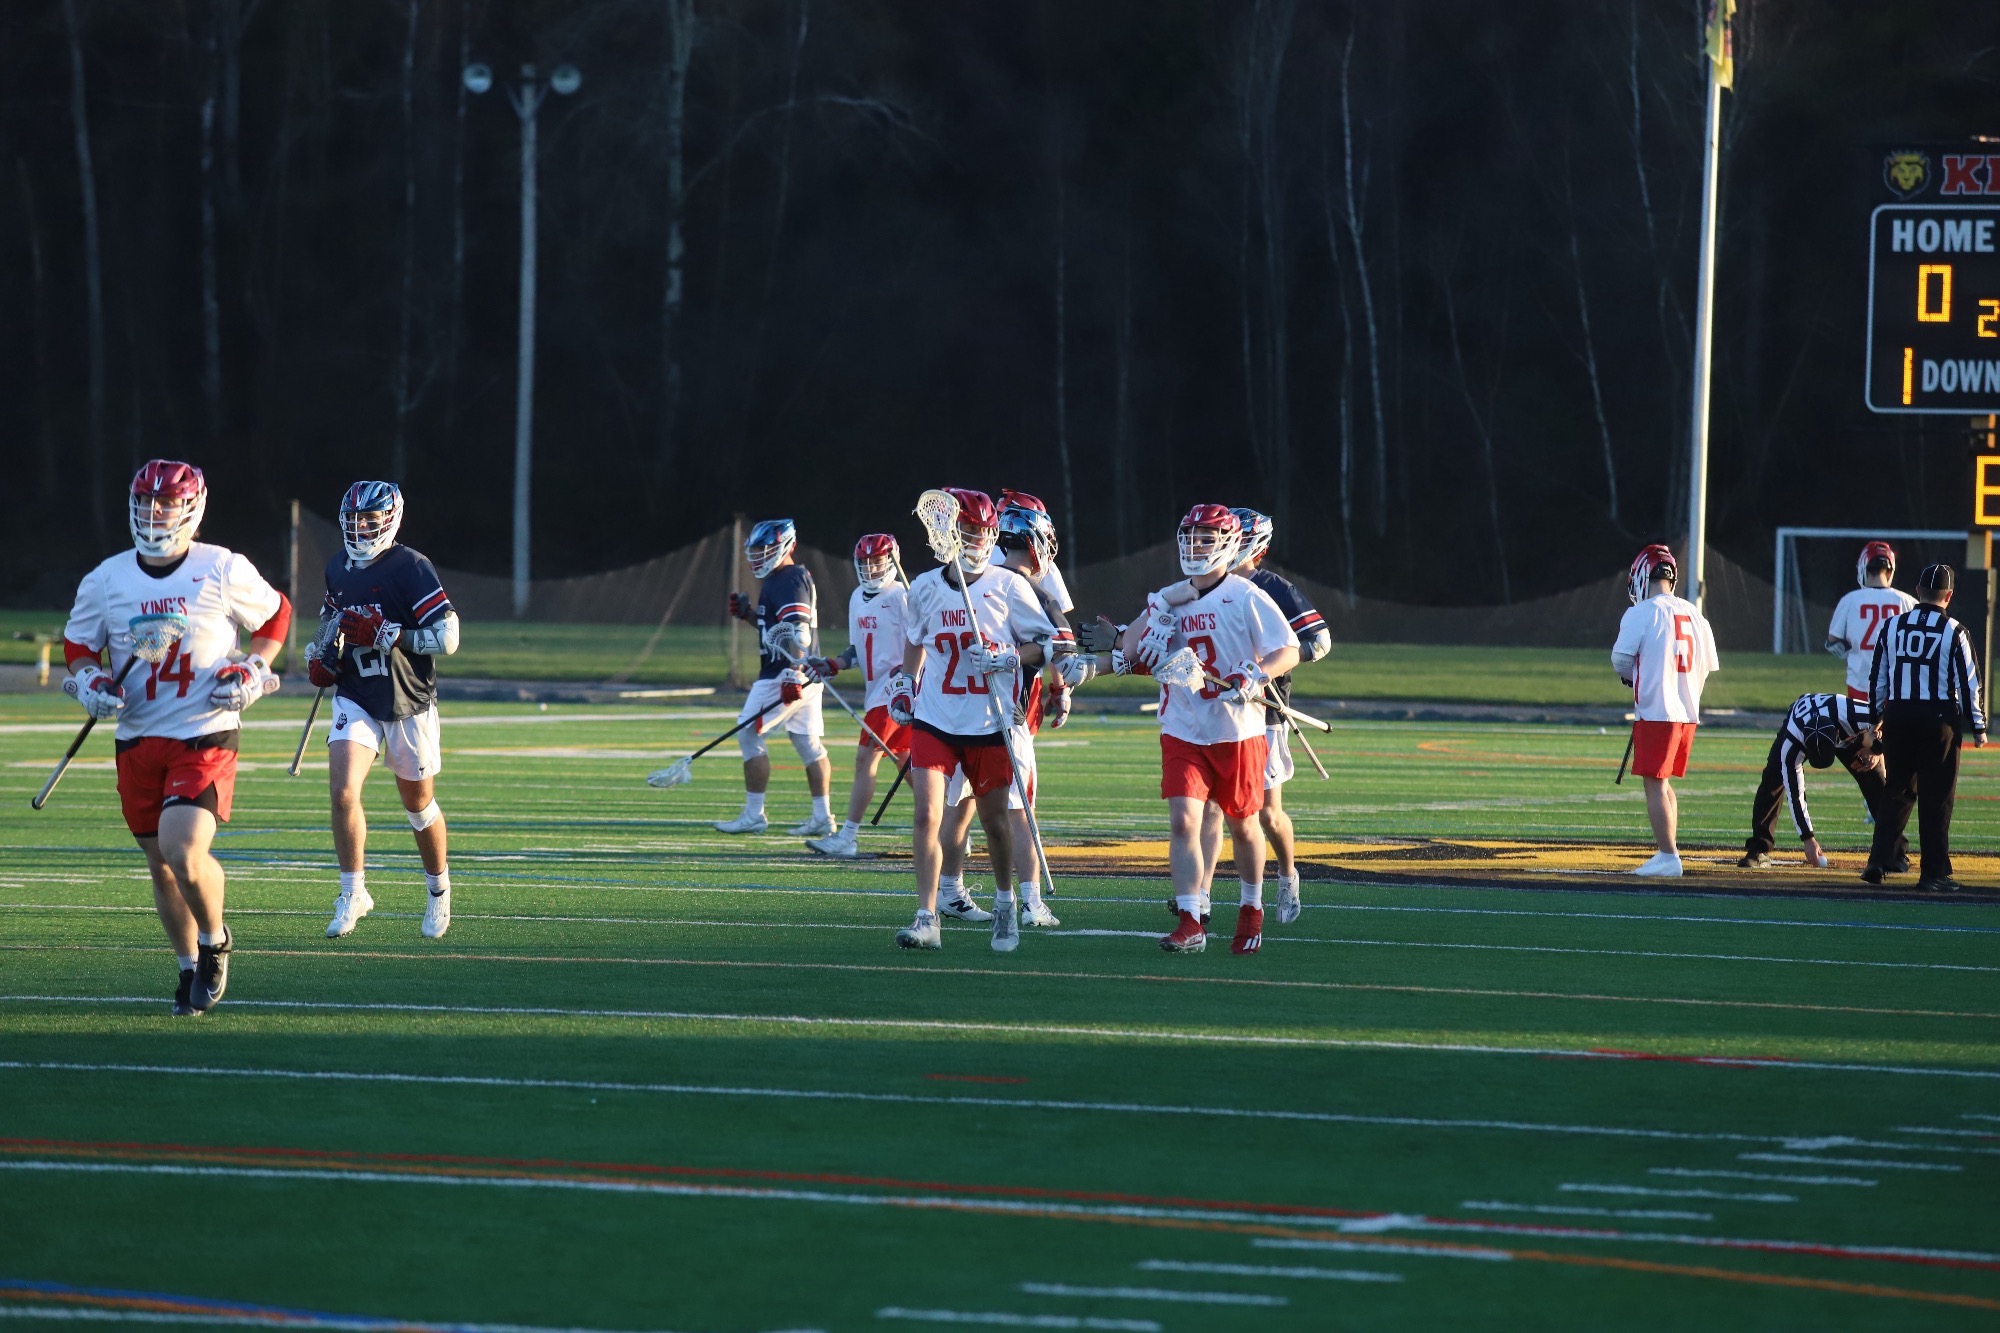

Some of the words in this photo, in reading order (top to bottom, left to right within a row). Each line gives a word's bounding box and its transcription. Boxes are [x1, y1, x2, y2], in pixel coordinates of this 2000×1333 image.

[1892, 218, 1995, 253] HOME
[1917, 264, 1952, 323] 0
[1977, 299, 2000, 338] 2
[1921, 358, 2000, 394] DOWN
[141, 597, 188, 616] KING'S
[941, 608, 977, 628] KING
[1181, 613, 1216, 633] KING'S
[1673, 614, 1694, 674] 5
[1896, 628, 1944, 660] 107
